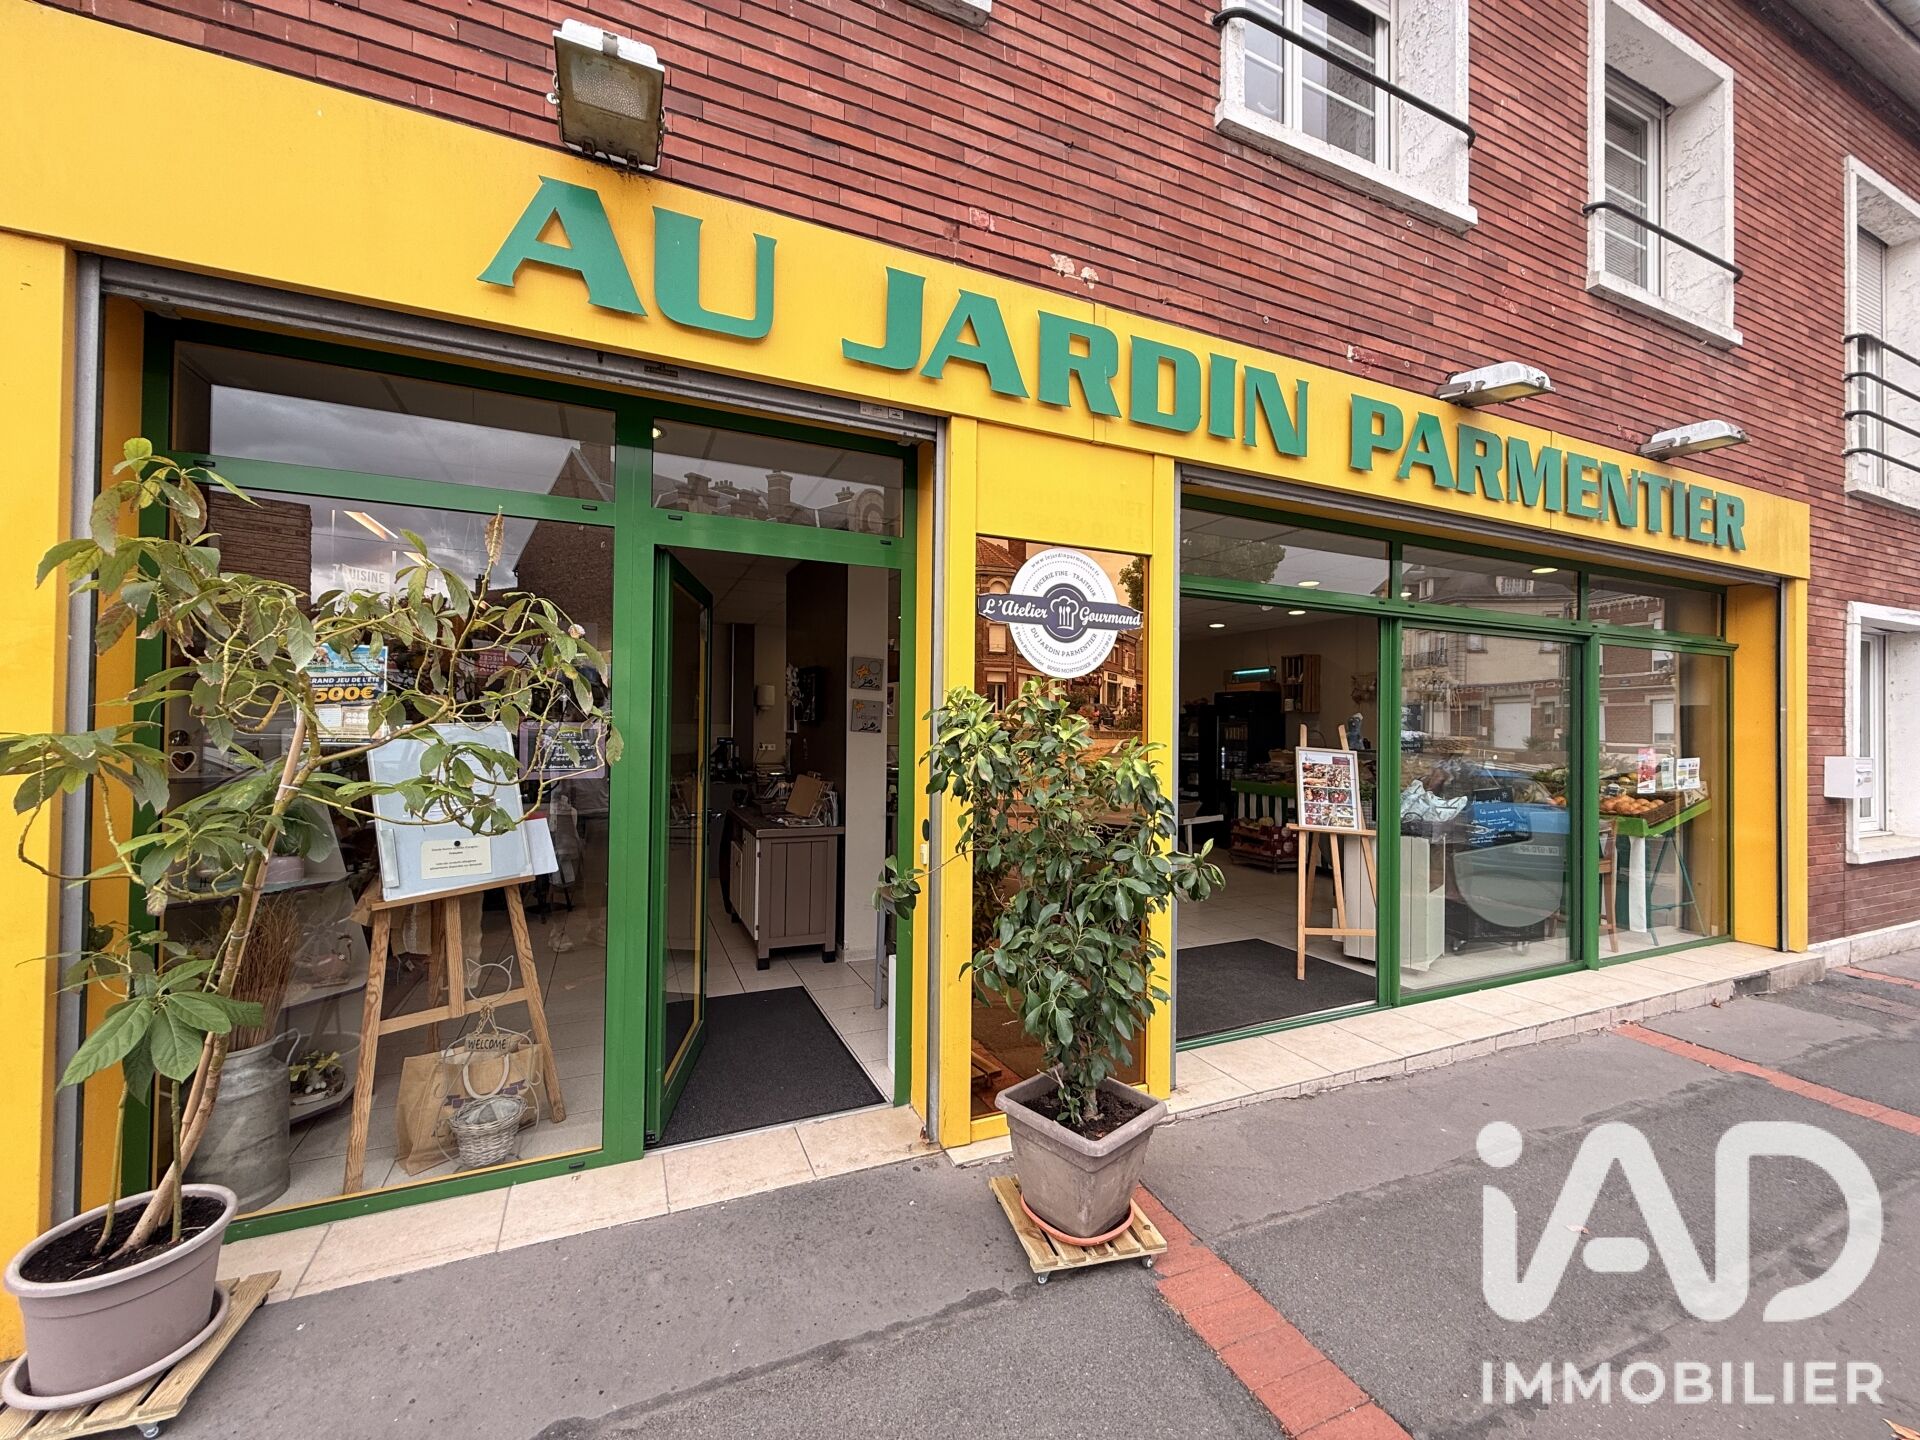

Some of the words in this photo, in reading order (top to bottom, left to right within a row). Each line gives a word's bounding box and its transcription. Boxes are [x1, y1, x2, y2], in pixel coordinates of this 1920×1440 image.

[476, 175, 777, 340] AU
[841, 266, 1309, 458] JARDIN
[1350, 393, 1746, 551] PARMENTIER
[347, 567, 385, 584] UISINE
[1073, 572, 1096, 598] TRAITEUR
[983, 598, 1048, 619] L'Atelier
[1079, 607, 1142, 626] Gourmand
[1030, 627, 1040, 638] DU
[1038, 635, 1060, 657] JARDIN
[1061, 633, 1097, 658] PARMENTIER
[314, 686, 377, 704] 500€
[467, 1038, 507, 1051] WELCOME
